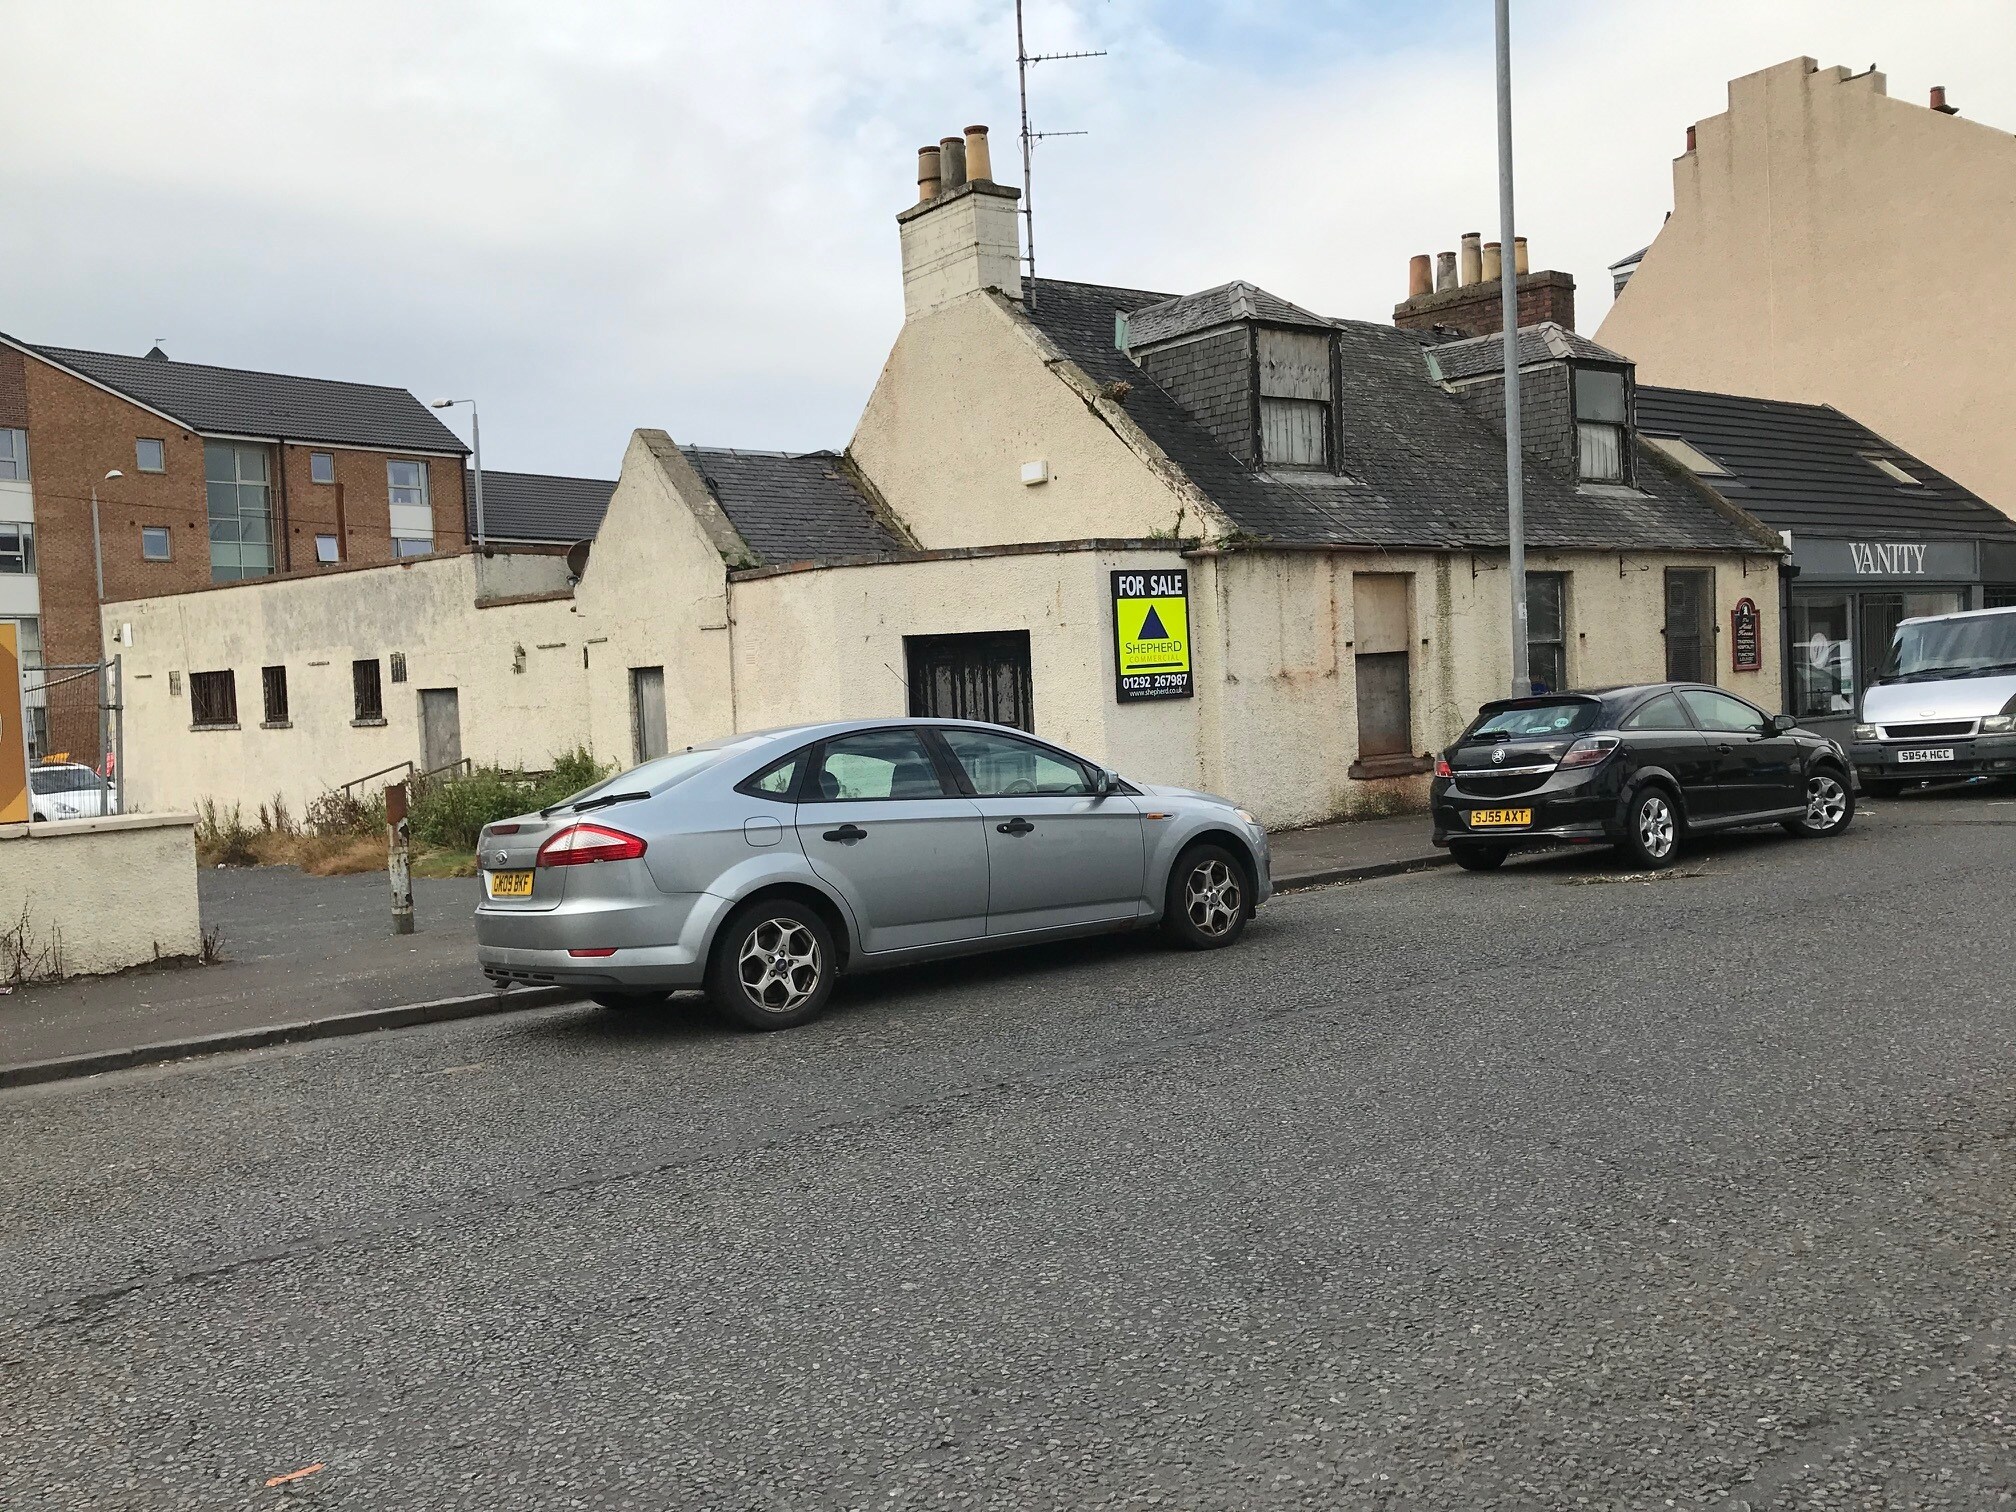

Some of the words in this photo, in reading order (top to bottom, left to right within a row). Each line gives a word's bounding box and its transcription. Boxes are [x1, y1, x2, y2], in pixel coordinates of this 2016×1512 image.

[1848, 542, 1927, 574] VANITY
[1118, 575, 1146, 597] FOR
[1150, 574, 1183, 596] SALE
[1125, 640, 1182, 655] SHEPHERD
[1129, 654, 1180, 664] COMMERCIAL
[1122, 676, 1151, 690] 01292
[1154, 673, 1188, 687] 267987
[1129, 687, 1182, 696] www.shepherd.co.uk
[1475, 811, 1502, 823] SJ55
[1504, 810, 1526, 823] AXT
